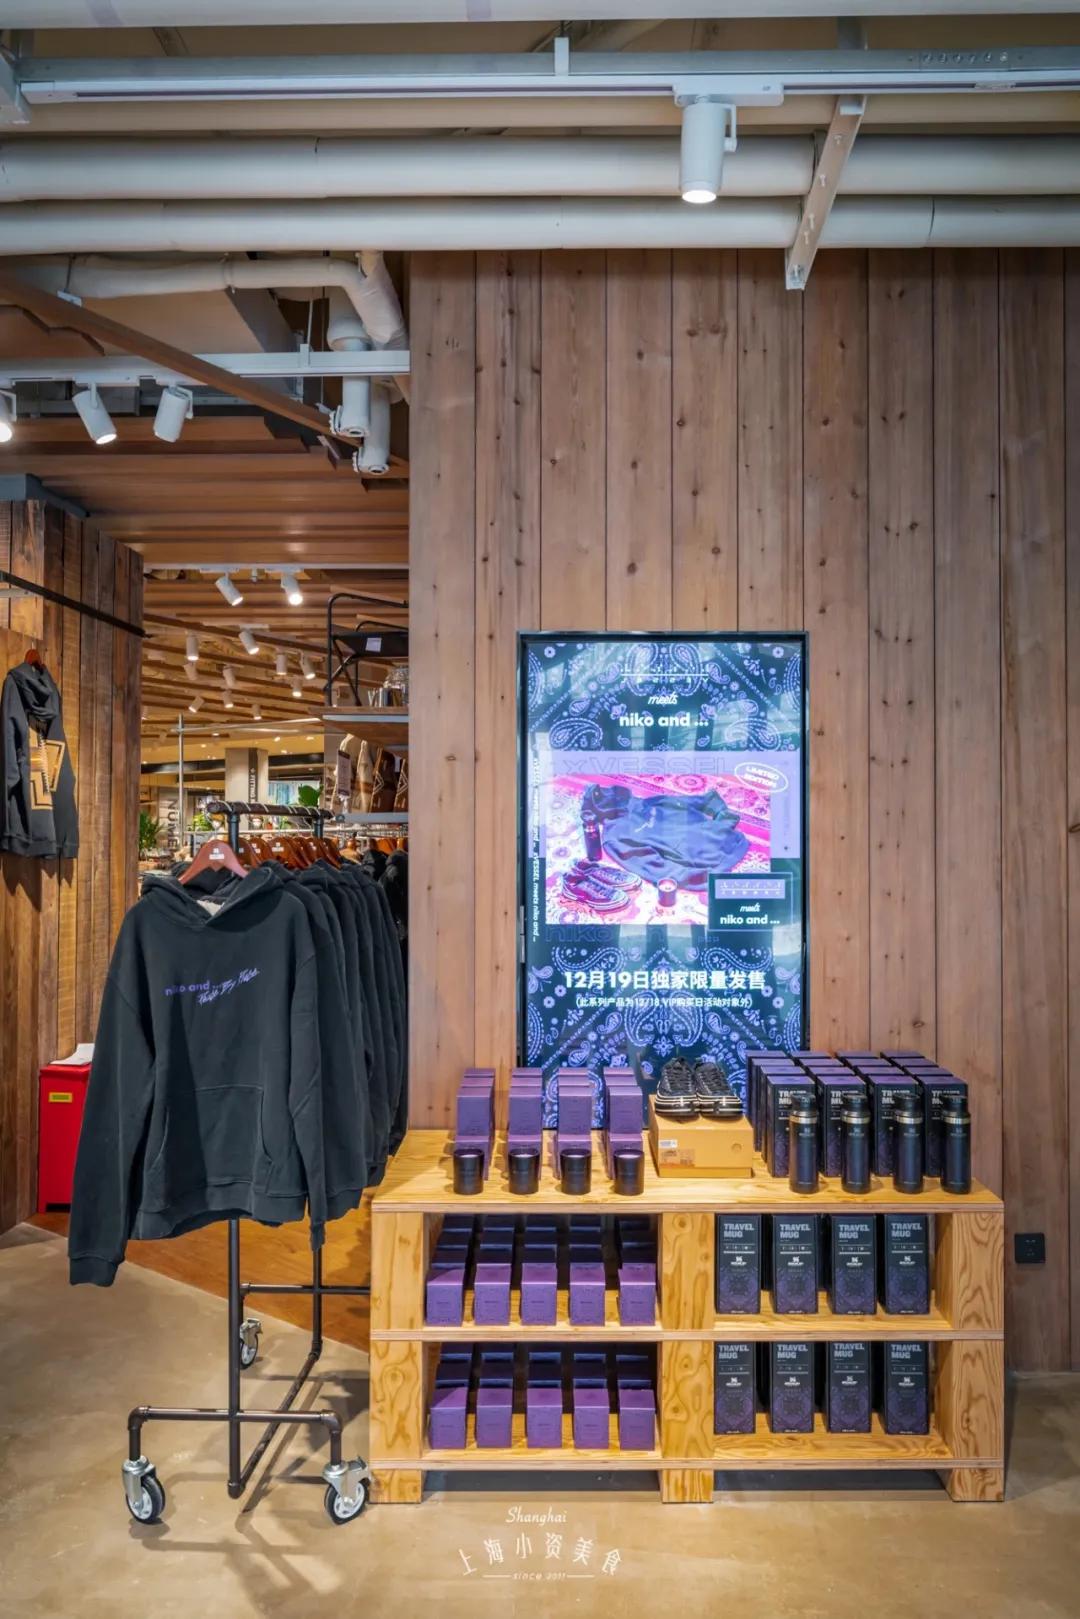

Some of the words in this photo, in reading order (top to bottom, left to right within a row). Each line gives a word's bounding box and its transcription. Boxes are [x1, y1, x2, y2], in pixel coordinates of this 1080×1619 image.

[620, 712, 654, 727] niko
[658, 712, 691, 727] and
[720, 914, 744, 925] niko
[746, 914, 768, 925] and
[564, 970, 766, 990] 12月19日独家限量发售
[724, 1223, 754, 1231] TRAVEL
[780, 1223, 811, 1231] TRAVEL
[839, 1224, 870, 1232] TRAVEL
[891, 1222, 922, 1231] TRAVEL
[724, 1230, 743, 1238] MUG
[780, 1231, 799, 1239] MUG
[839, 1231, 858, 1239] MUG
[718, 1344, 749, 1352] TRAVEL
[777, 1344, 808, 1352] TRAVEL
[834, 1342, 864, 1350] TRAVEL
[891, 1343, 922, 1352] TRAVEL
[718, 1351, 738, 1359] MUG
[777, 1351, 797, 1359] MUG
[834, 1350, 853, 1358] MUG
[891, 1351, 911, 1359] MUG
